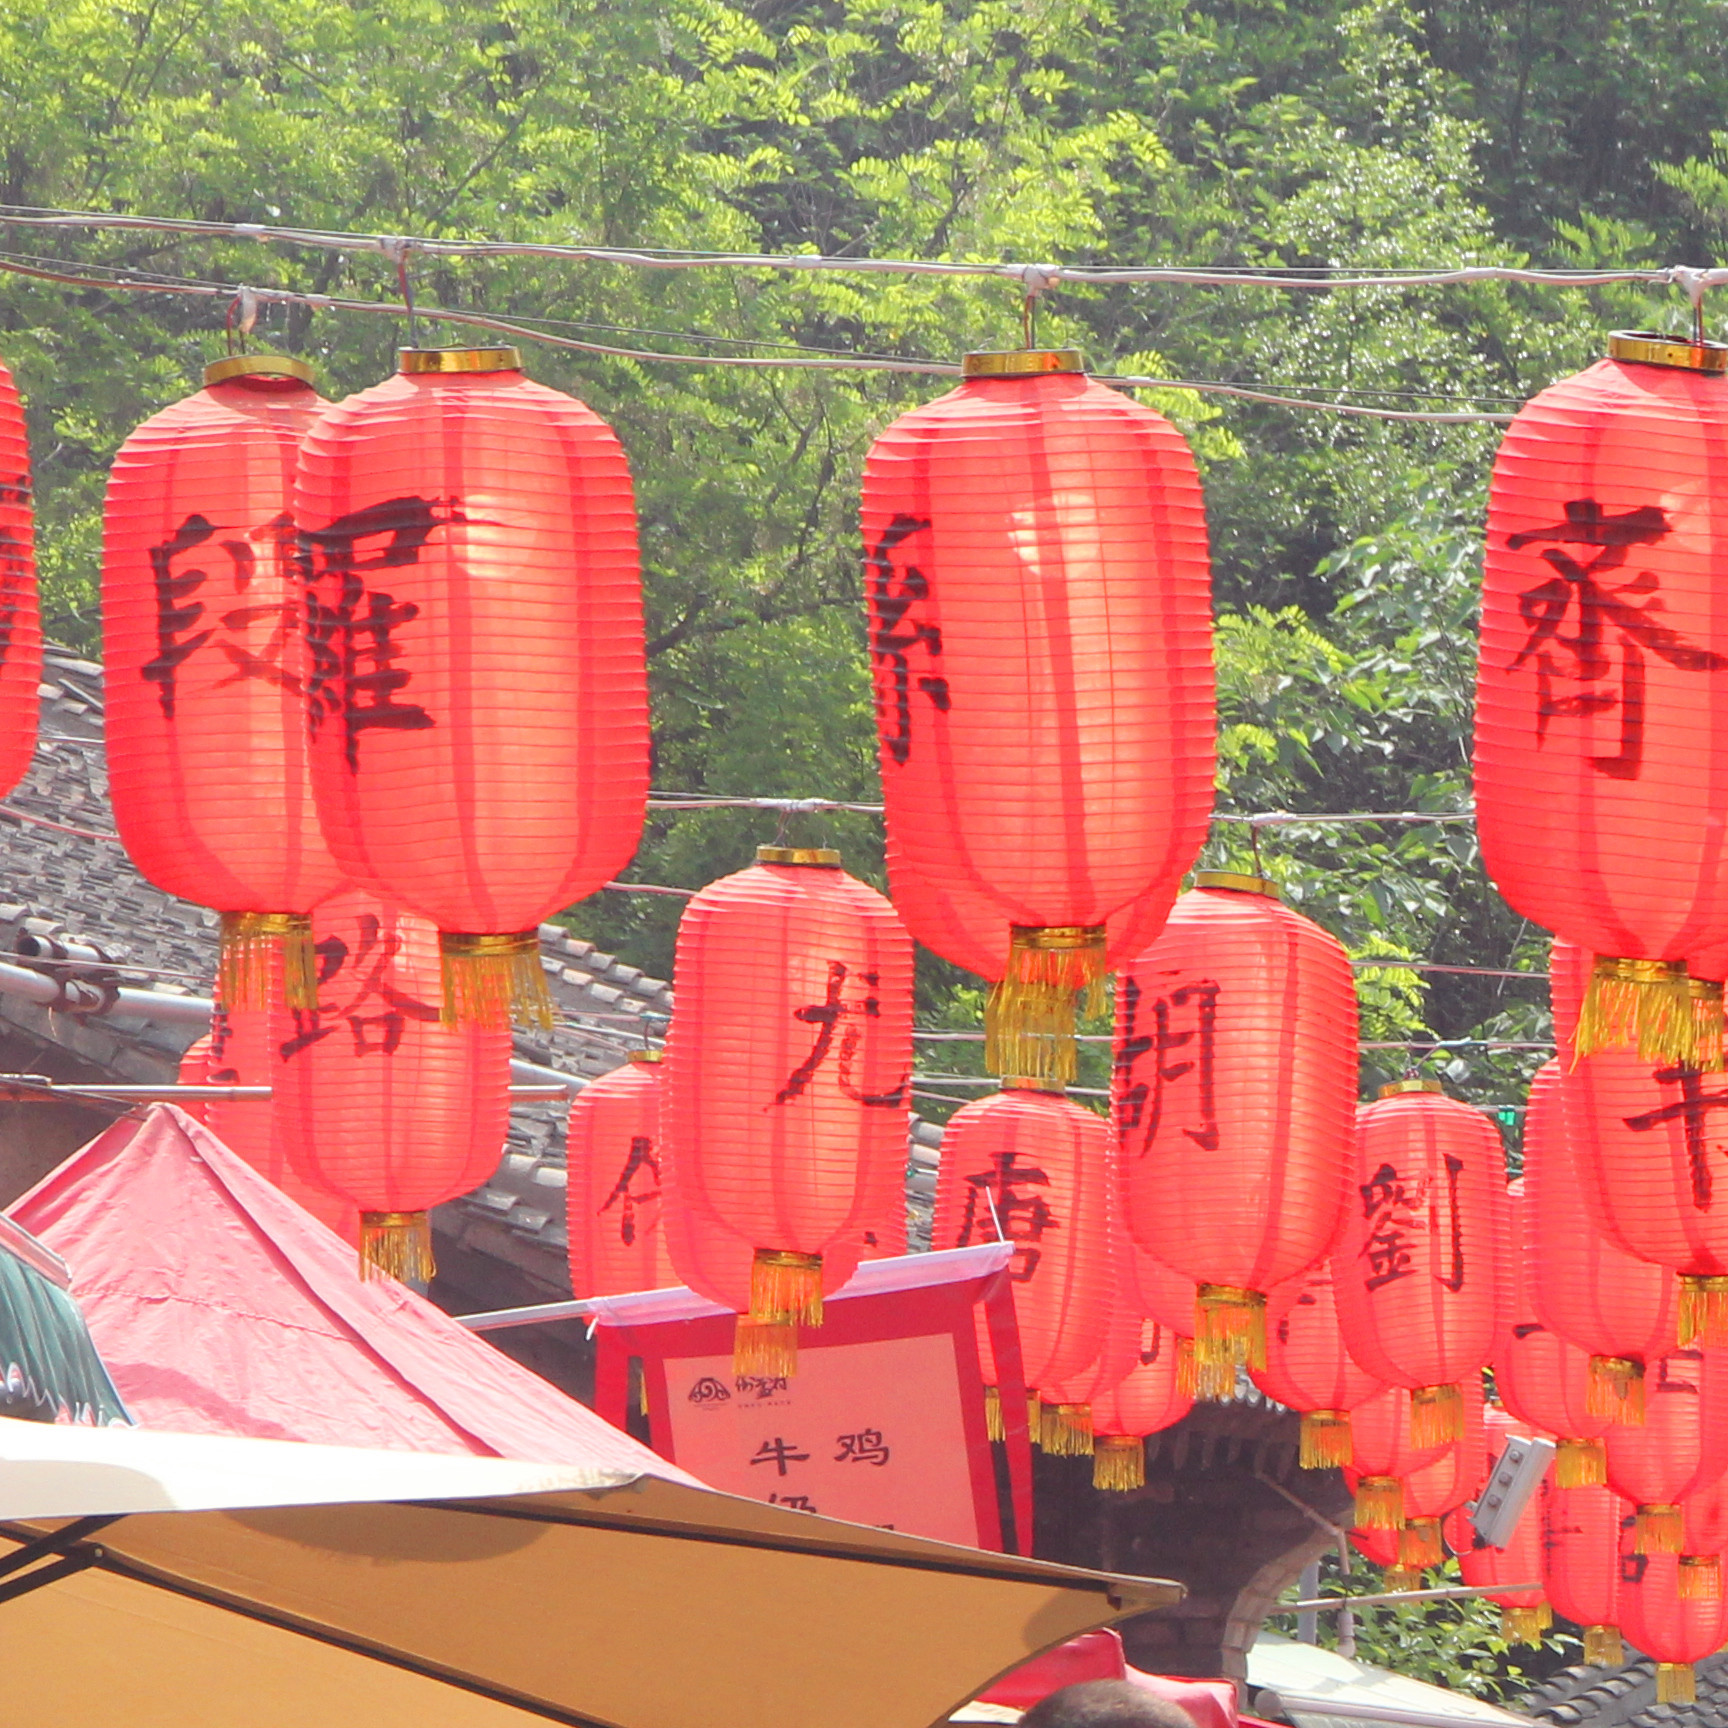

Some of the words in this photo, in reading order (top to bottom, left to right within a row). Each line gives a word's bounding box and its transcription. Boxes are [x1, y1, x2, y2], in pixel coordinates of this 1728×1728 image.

[280, 914, 444, 1061] 路
[1112, 977, 1221, 1159] 胡
[955, 1152, 1060, 1283] 唐
[1358, 1152, 1465, 1293] 劉
[833, 1427, 894, 1531] 鸡
